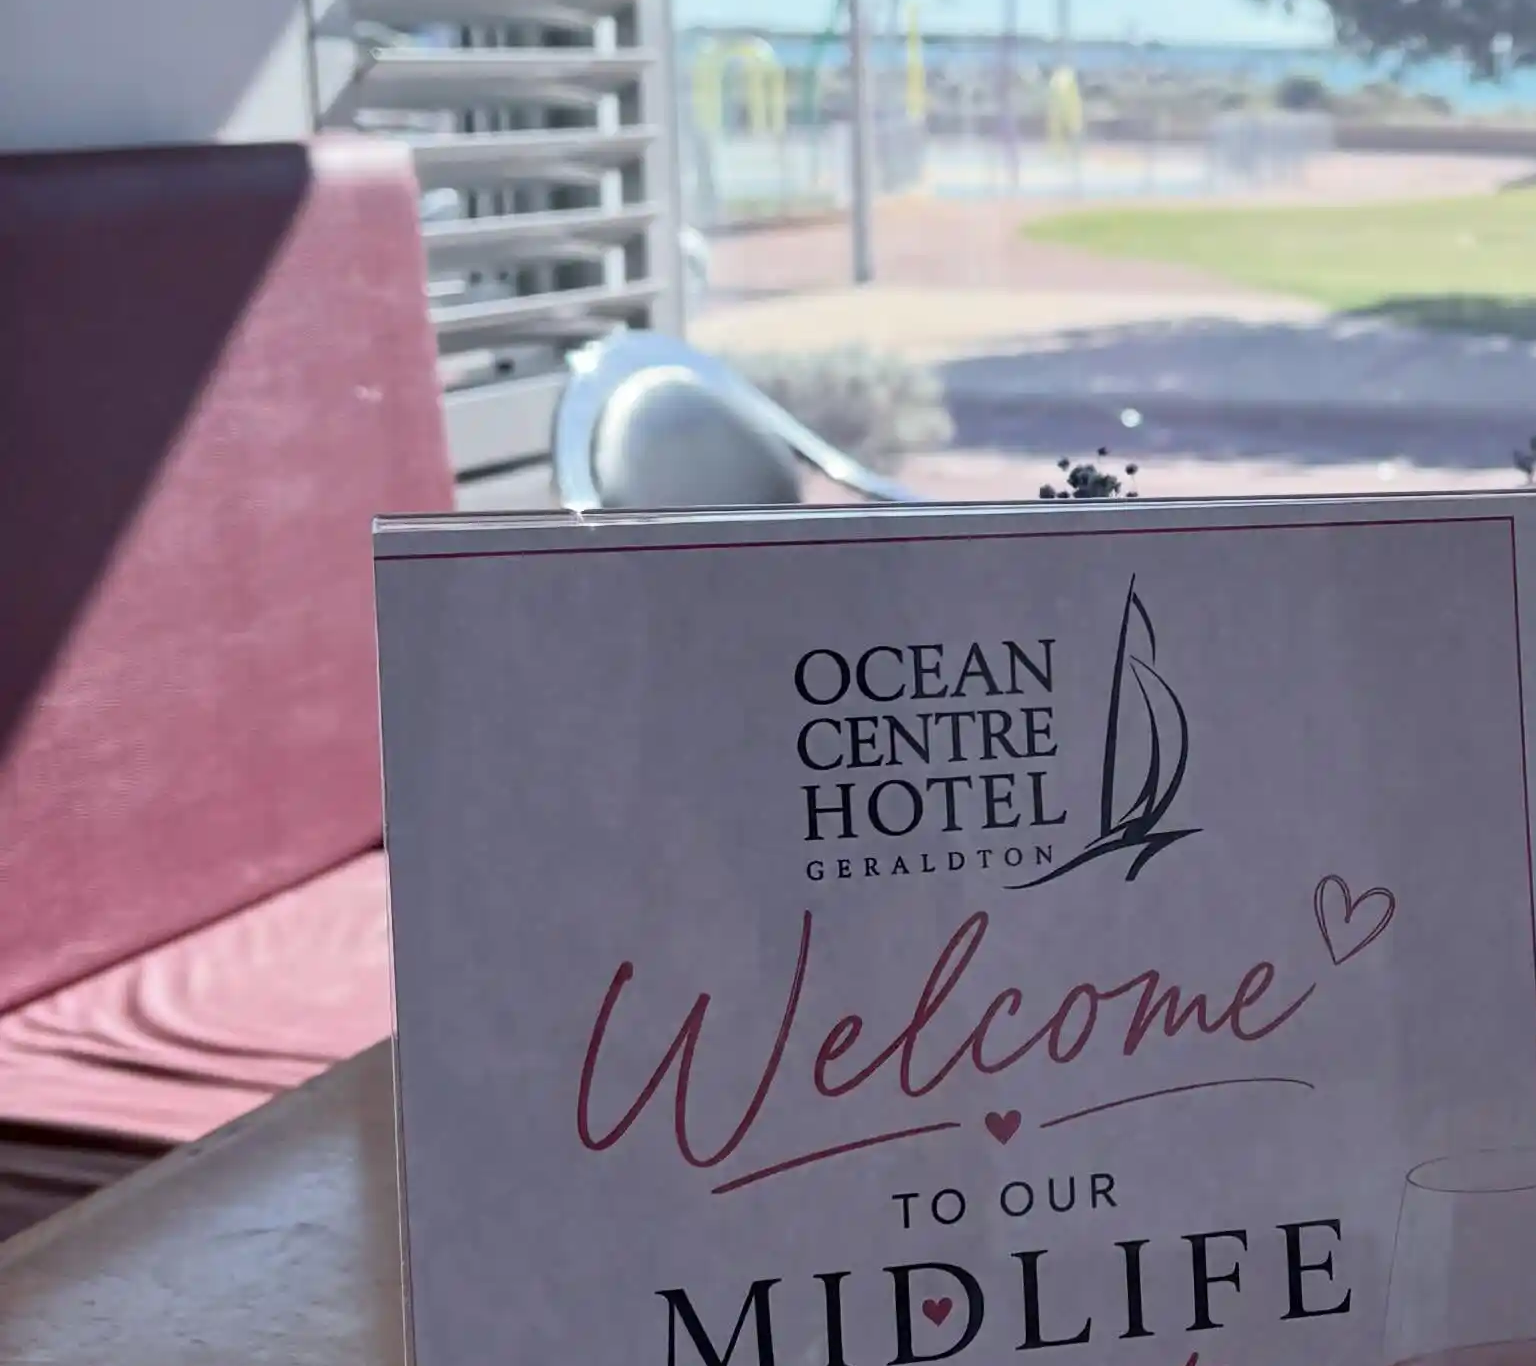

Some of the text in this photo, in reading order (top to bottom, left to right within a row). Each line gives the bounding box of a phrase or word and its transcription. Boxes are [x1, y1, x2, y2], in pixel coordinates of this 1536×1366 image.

[794, 639, 1056, 705] OCEAN
[797, 706, 1059, 771] CENTRE
[801, 771, 1067, 841] HOTEL
[806, 844, 1053, 881] GERALDTON
[577, 910, 1317, 1167] Welcome
[892, 1173, 1119, 1229] TO OUR
